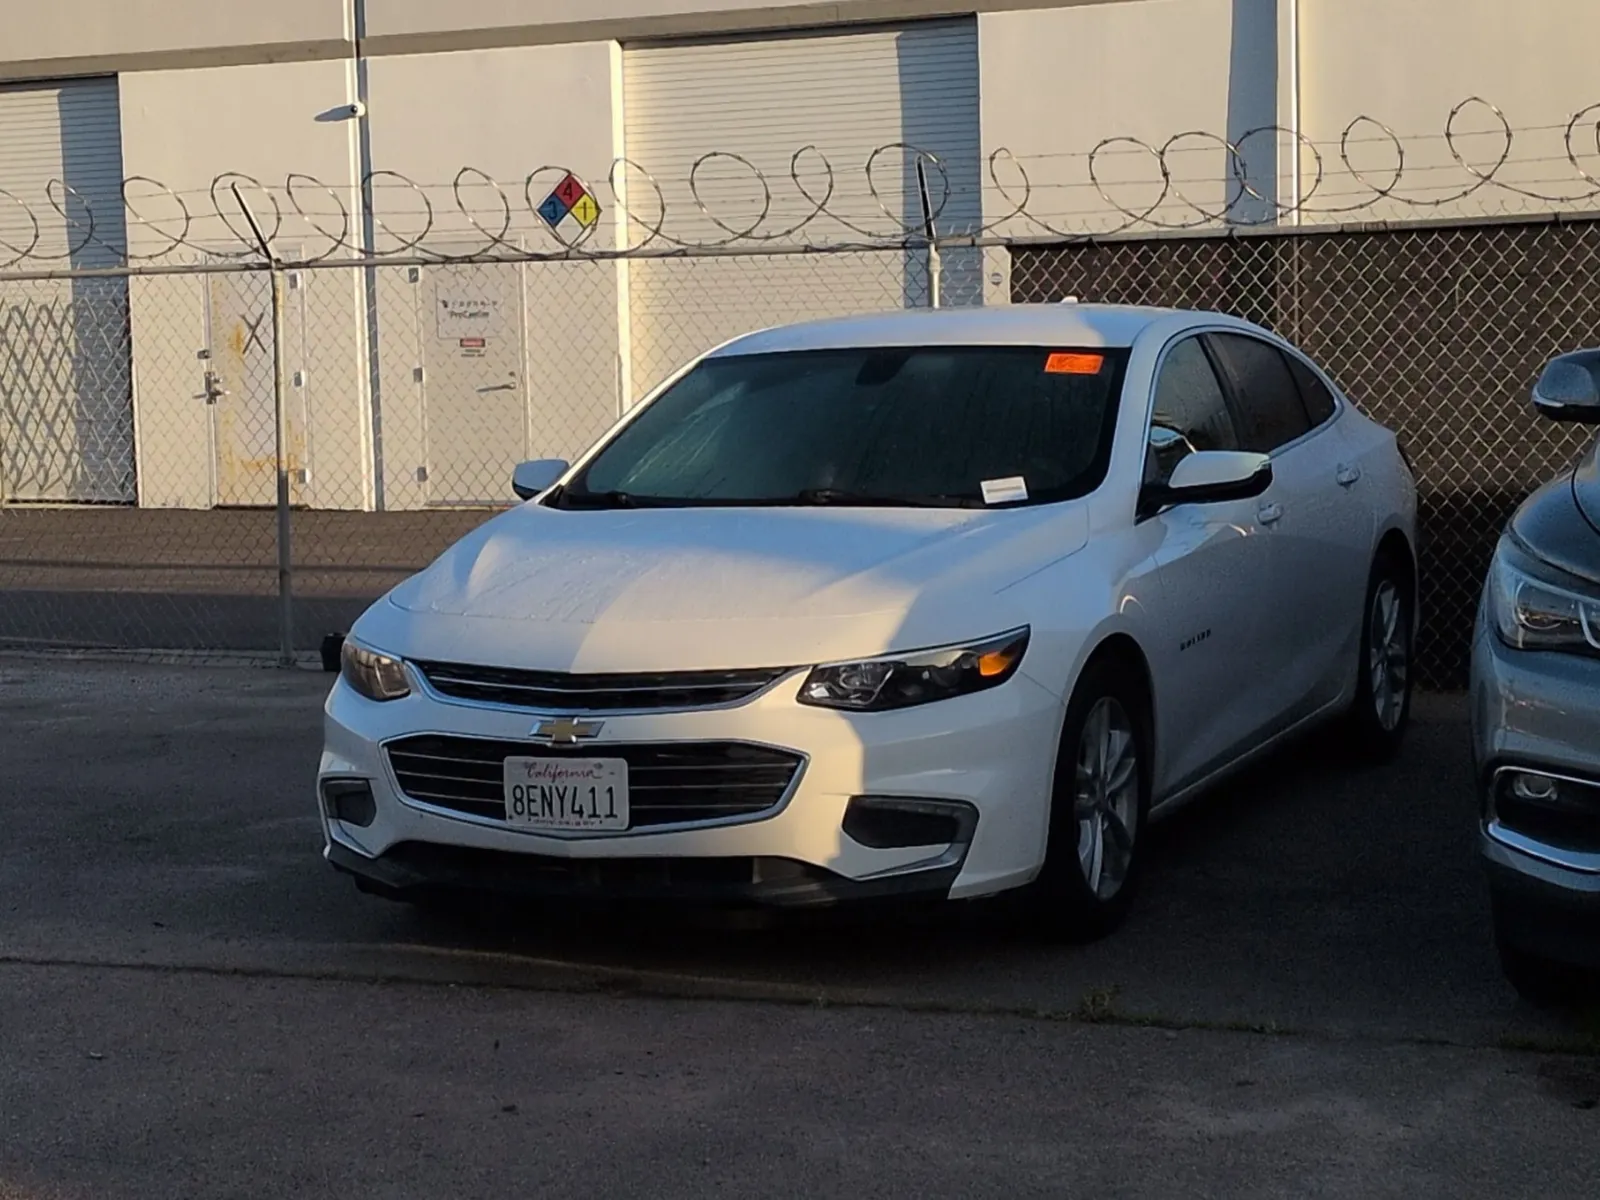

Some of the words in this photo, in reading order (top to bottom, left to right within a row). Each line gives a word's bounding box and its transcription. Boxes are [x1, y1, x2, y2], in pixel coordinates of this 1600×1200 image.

[563, 182, 573, 201] 4
[527, 761, 603, 783] California
[512, 784, 618, 818] 8ENY411
